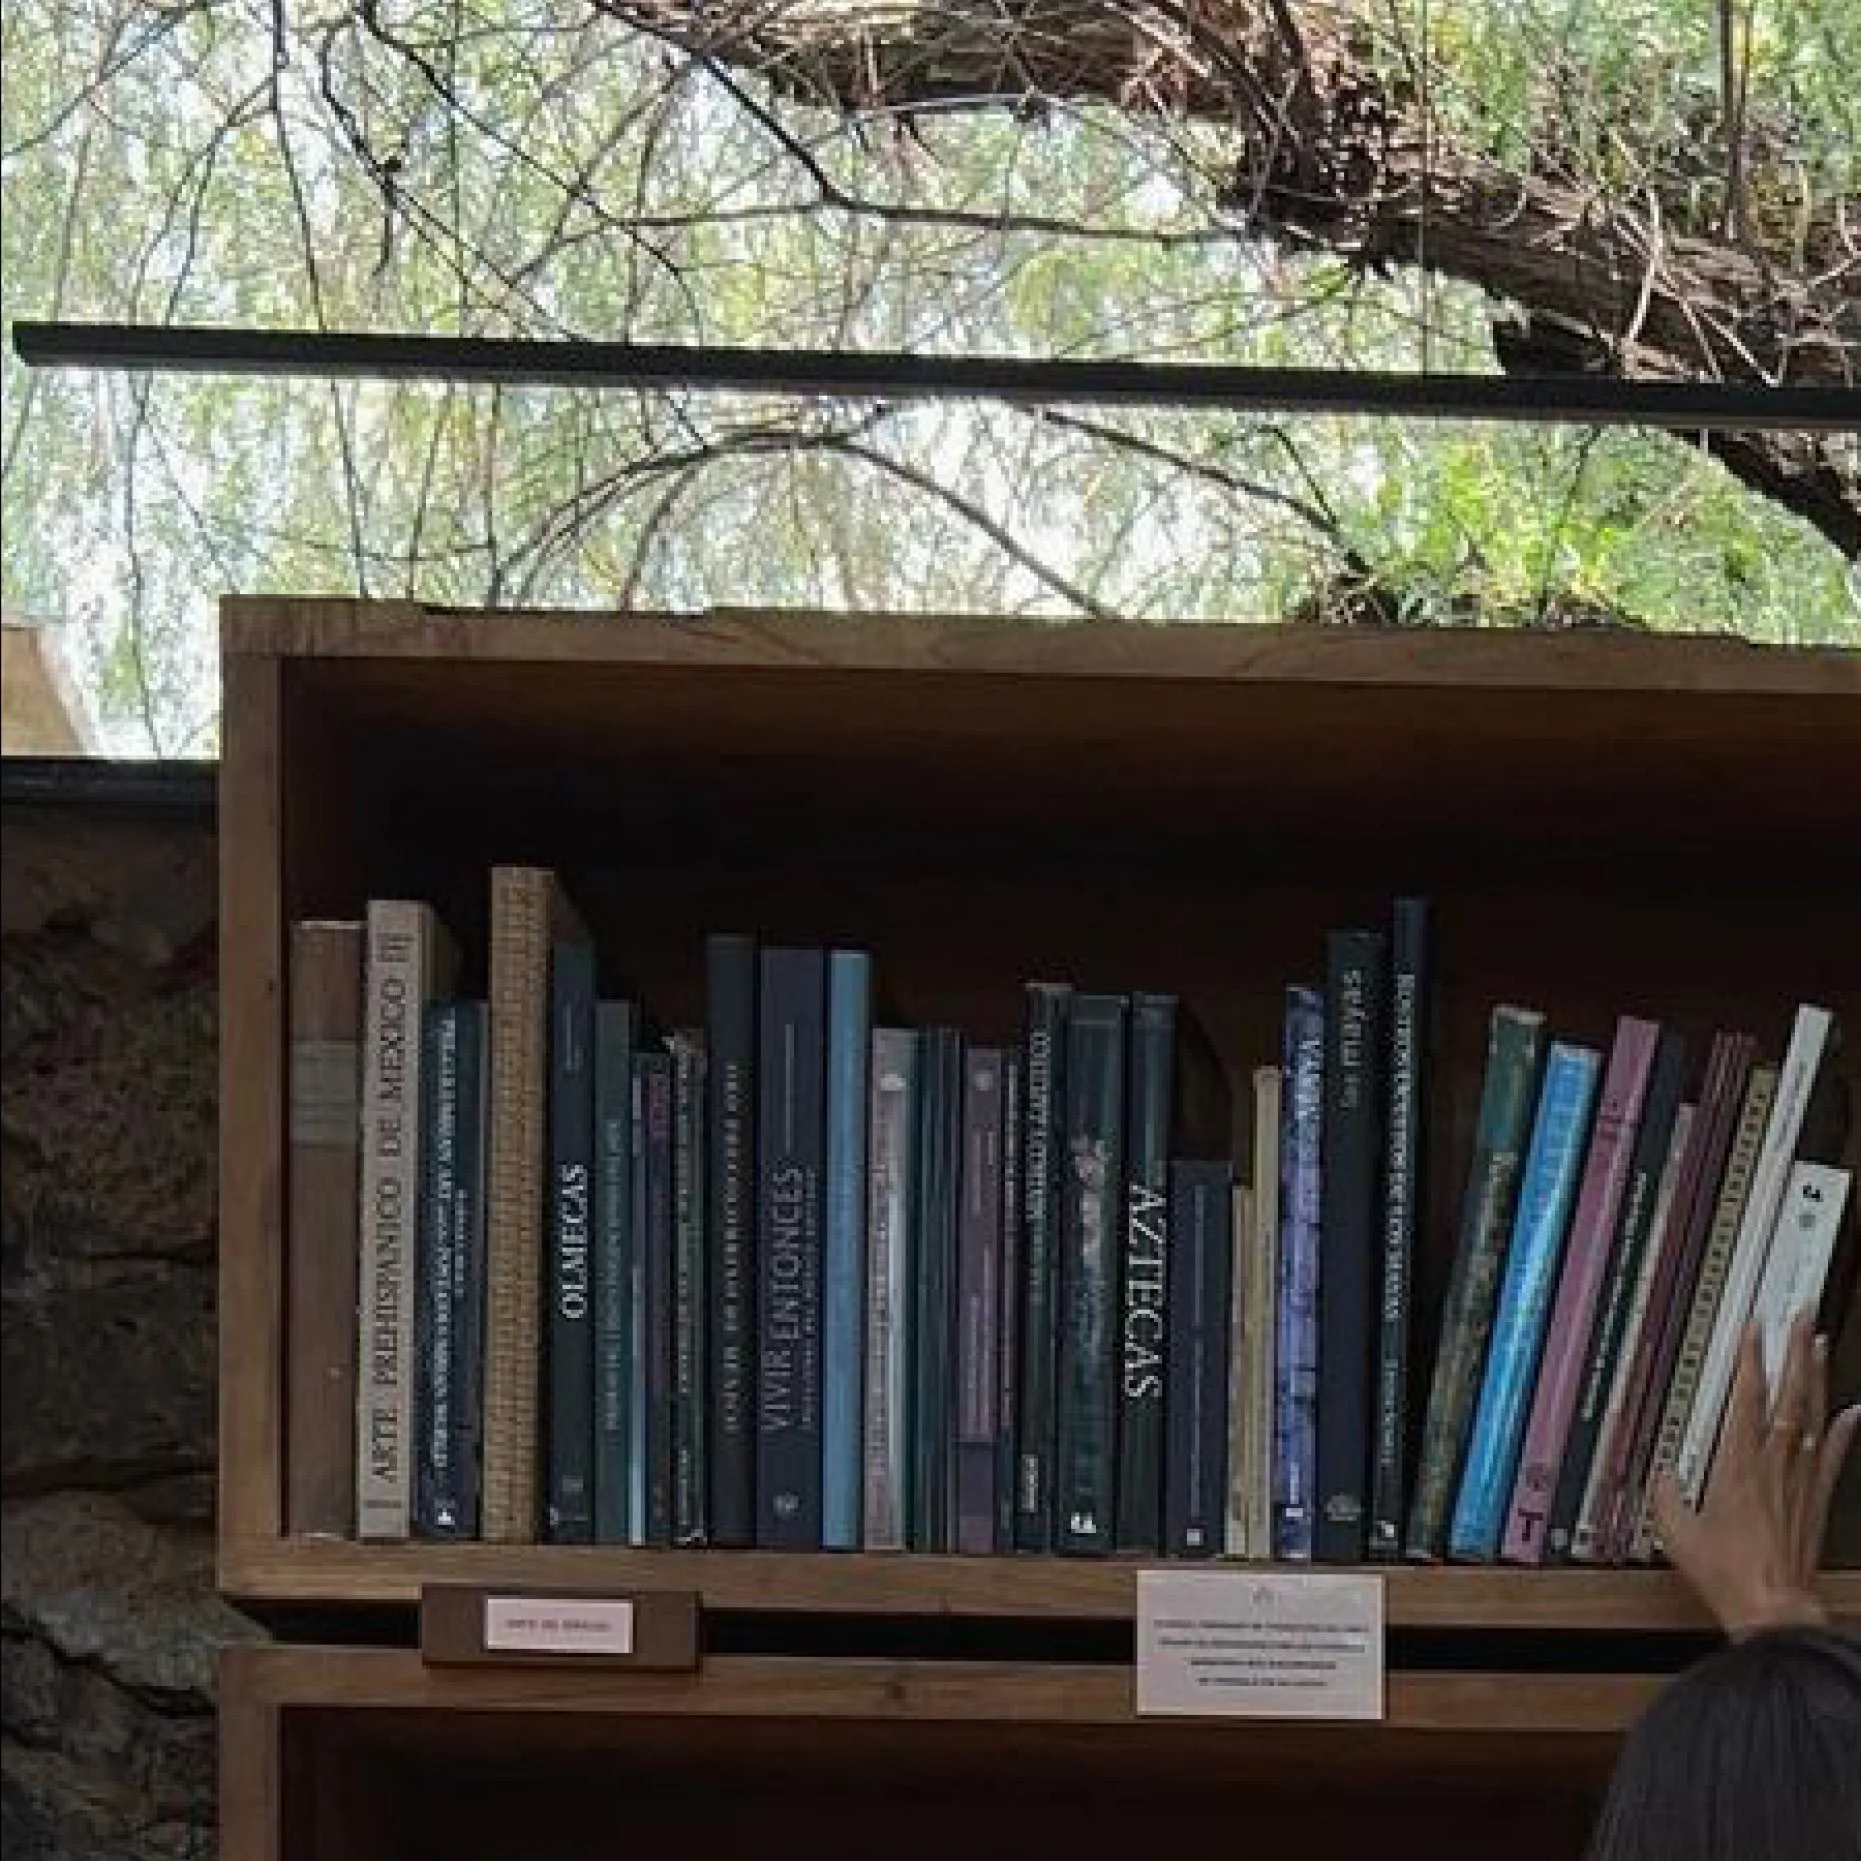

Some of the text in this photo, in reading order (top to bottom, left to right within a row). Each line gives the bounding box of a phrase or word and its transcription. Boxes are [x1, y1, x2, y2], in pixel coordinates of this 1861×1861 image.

[378, 977, 407, 1104] MEXICO
[377, 1117, 404, 1157] DE
[373, 1176, 405, 1386] PREHISPANICO
[560, 1164, 588, 1320] OLMECAS
[761, 1167, 803, 1432] VIVIR ENTONCES
[1123, 1182, 1168, 1400] AZTECAS
[372, 1408, 399, 1484] ARTE
